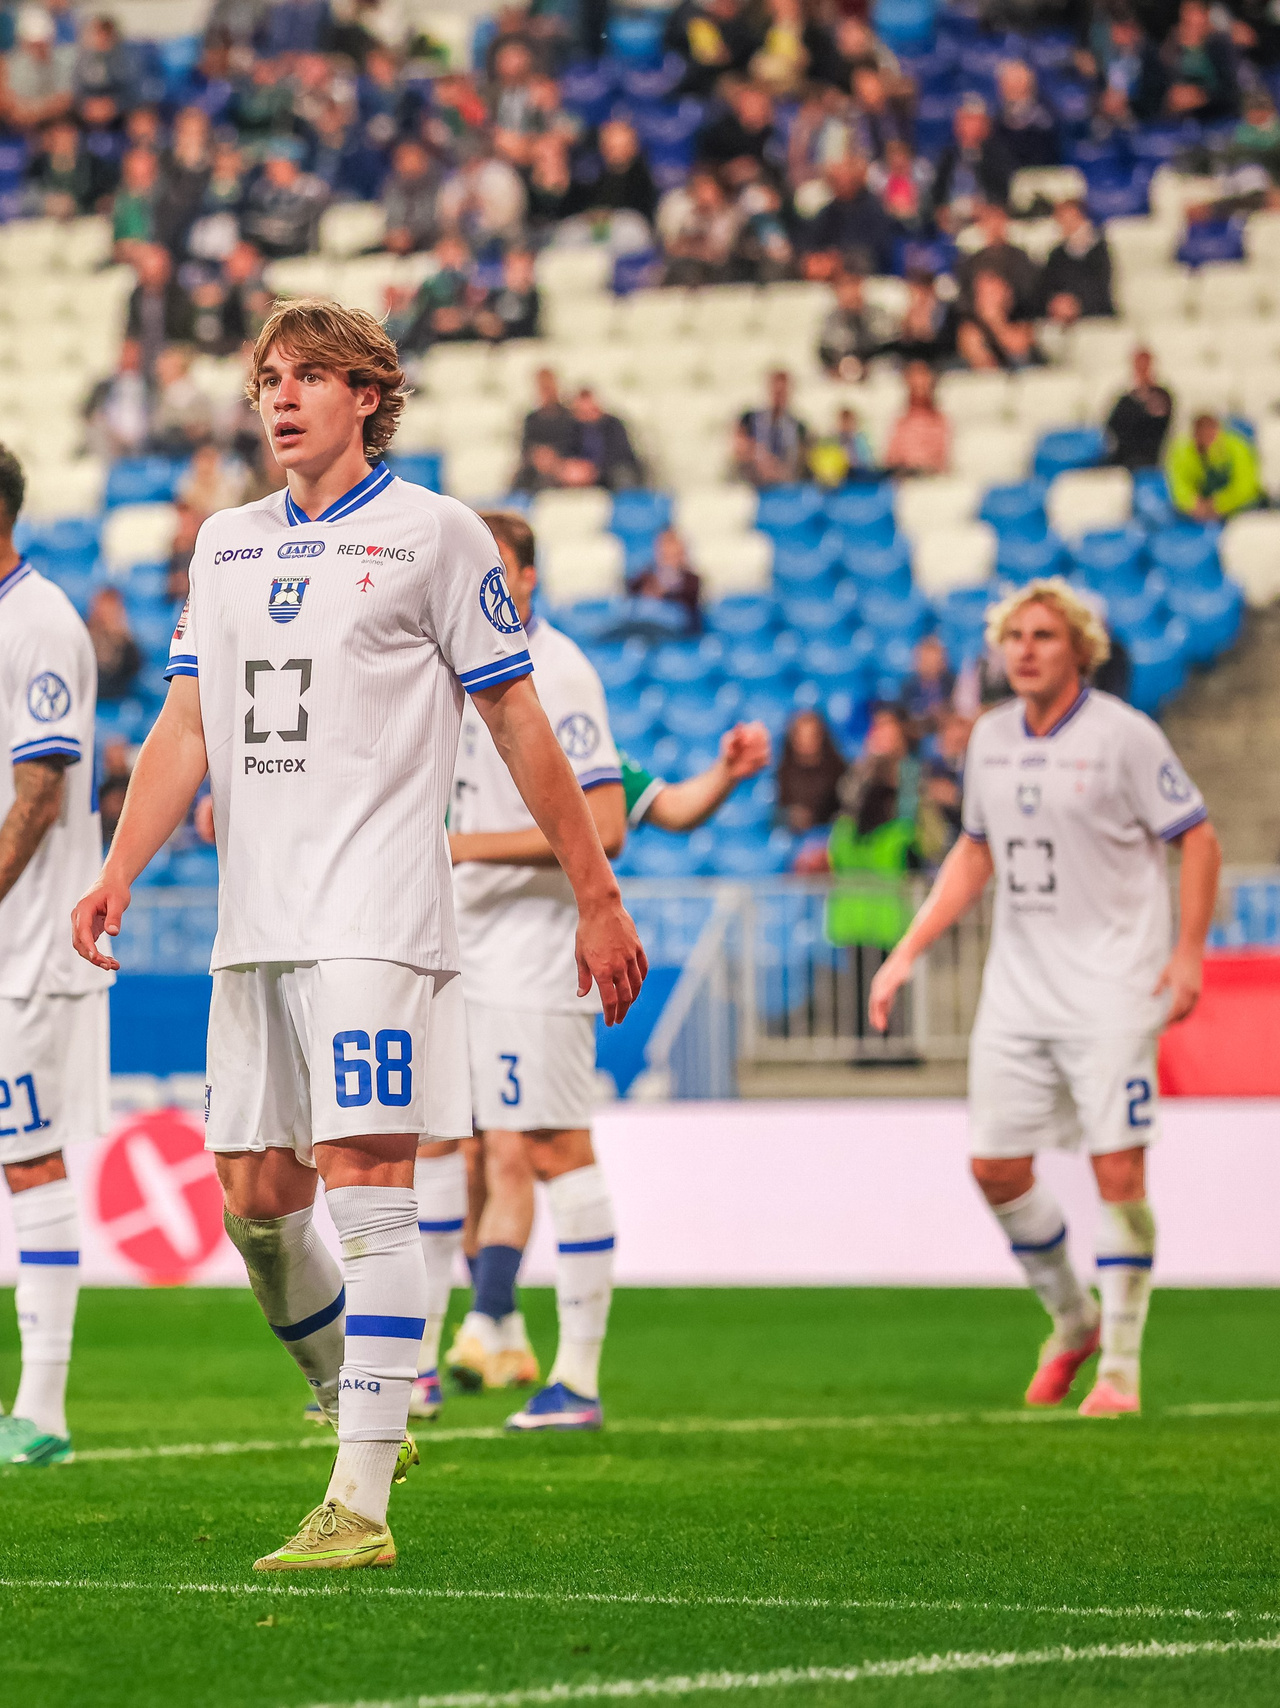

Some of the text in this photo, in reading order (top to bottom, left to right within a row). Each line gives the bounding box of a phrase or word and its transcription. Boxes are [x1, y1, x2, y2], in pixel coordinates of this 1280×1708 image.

[214, 547, 264, 565] согаз
[281, 544, 322, 555] JAKO
[244, 756, 307, 775] Ростех
[332, 1028, 413, 1108] 68
[499, 1054, 521, 1106] 3
[1126, 1079, 1152, 1127] 2
